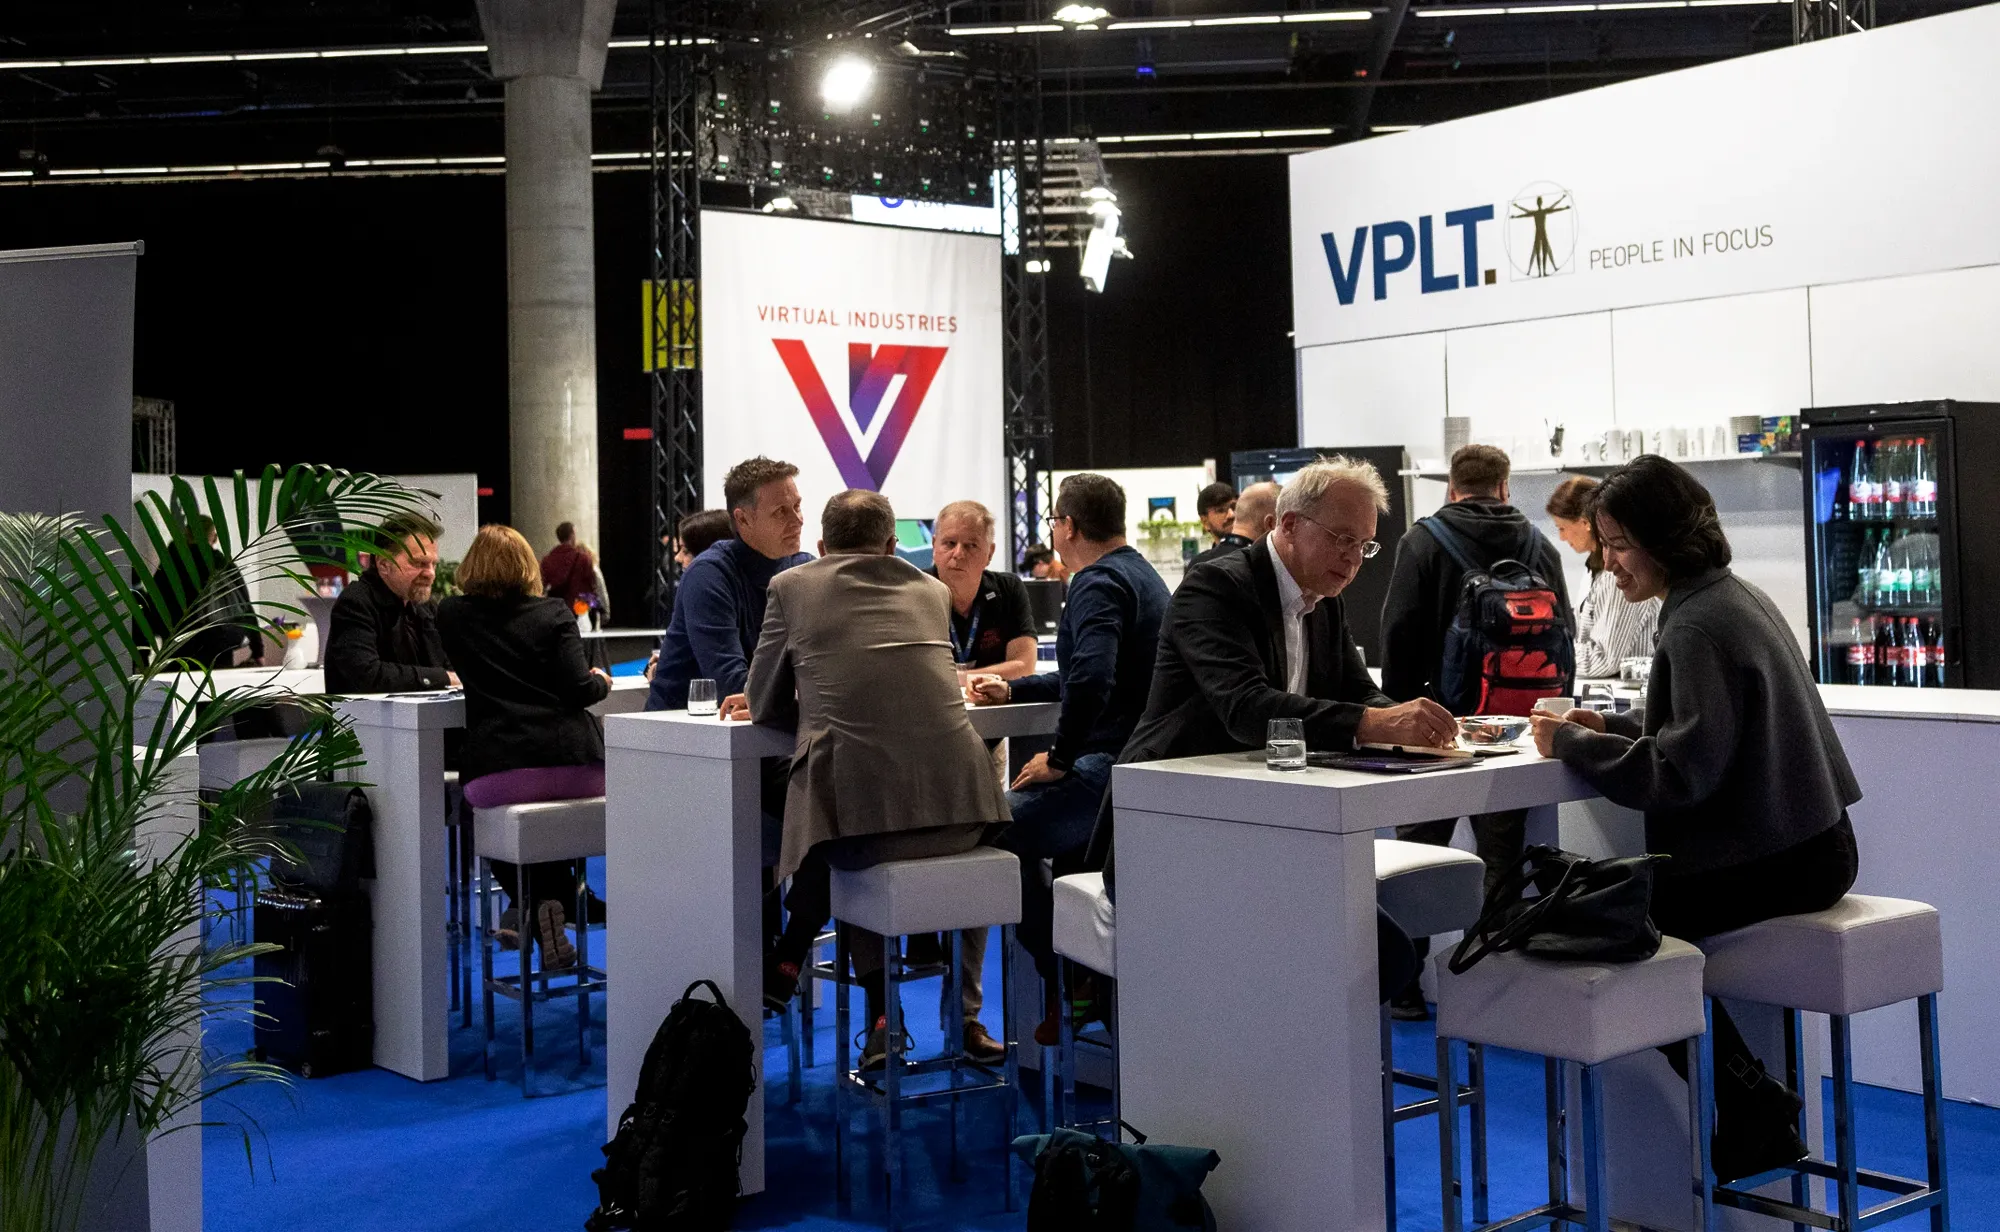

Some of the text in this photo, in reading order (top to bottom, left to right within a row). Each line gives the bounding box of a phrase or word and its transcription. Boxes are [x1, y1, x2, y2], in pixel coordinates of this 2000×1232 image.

[1589, 224, 1774, 271] PEOPLE IN FOCUS
[757, 304, 958, 334] VIRTUAL INDUSTRIES
